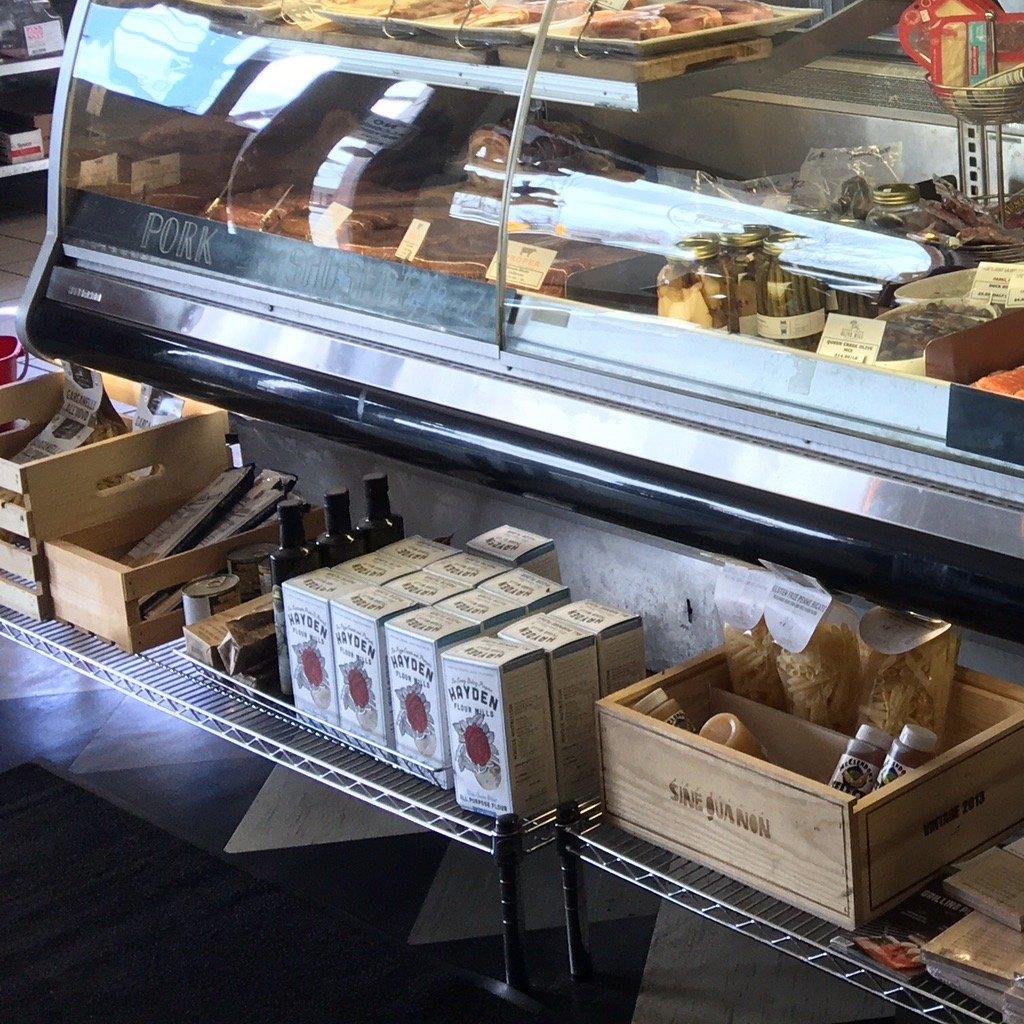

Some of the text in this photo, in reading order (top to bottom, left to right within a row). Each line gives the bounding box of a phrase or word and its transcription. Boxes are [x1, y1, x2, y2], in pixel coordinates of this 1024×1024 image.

[140, 211, 218, 266] PORK
[289, 612, 327, 639] HAYDEN
[335, 631, 375, 660] HAYDEN
[391, 654, 434, 682] HAYDEN
[448, 685, 499, 711] HAYDEN
[454, 703, 472, 713] FLOUR
[669, 778, 703, 811] SINE
[736, 807, 771, 839] NON
